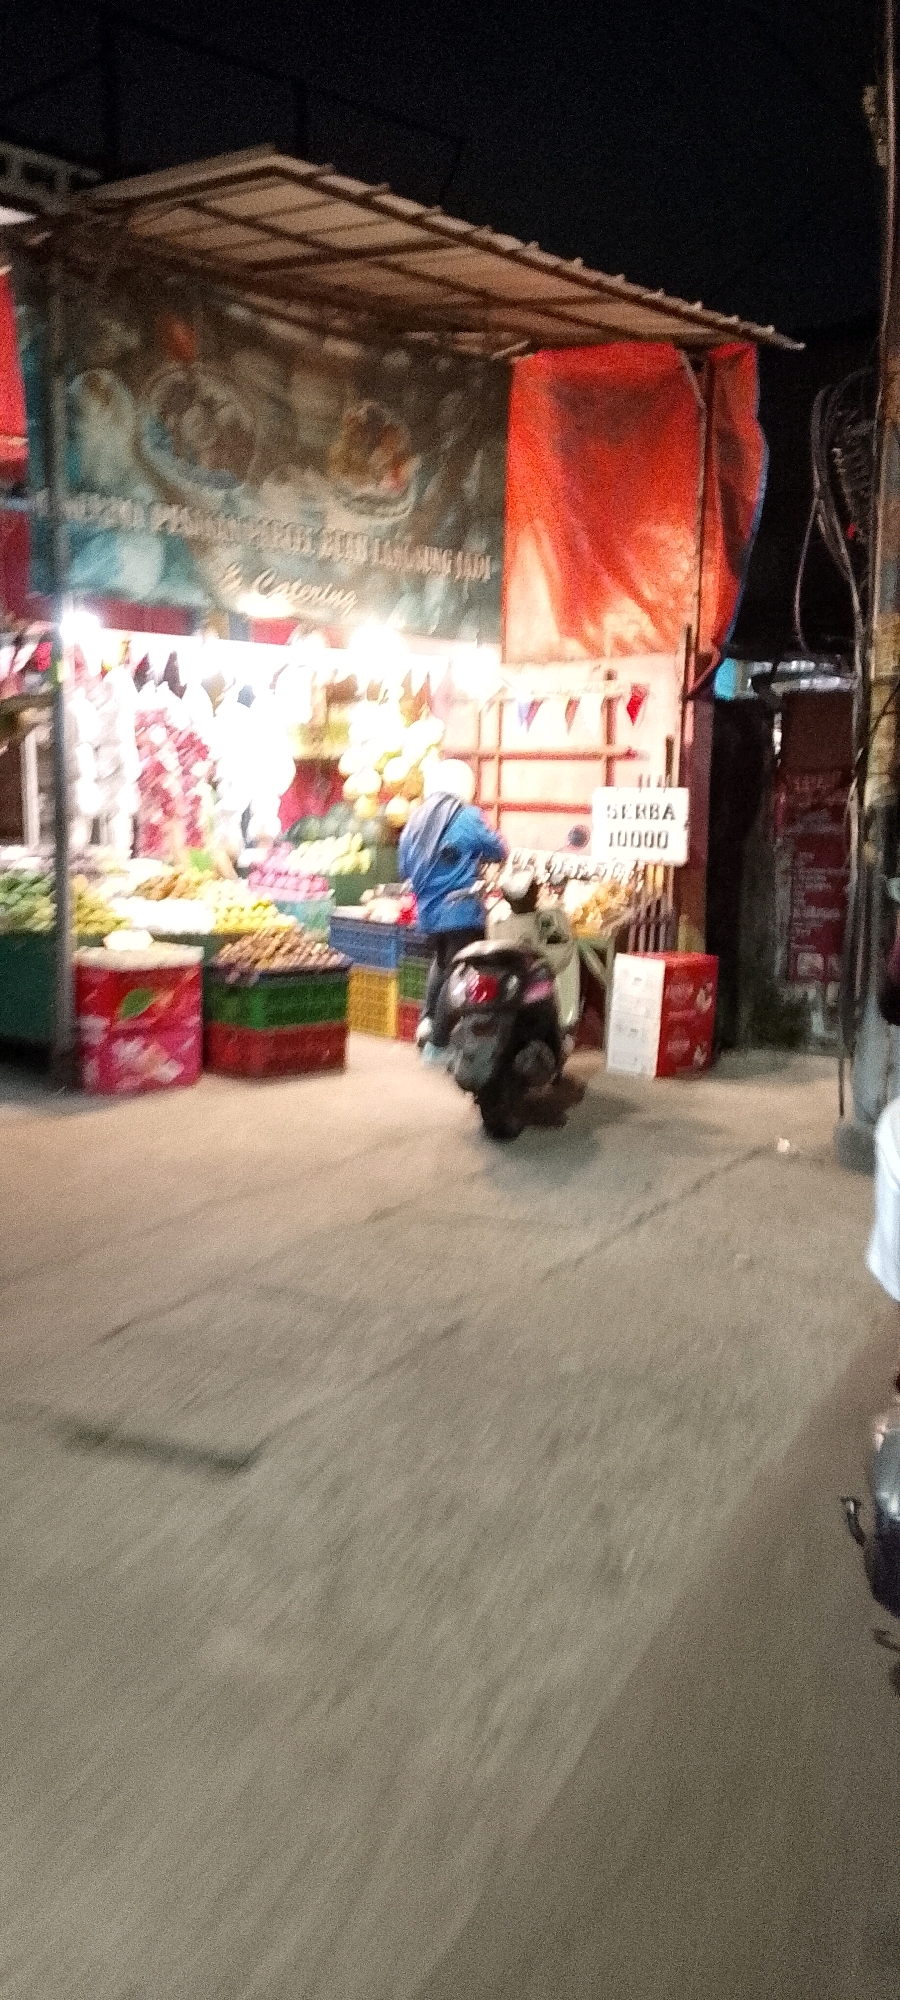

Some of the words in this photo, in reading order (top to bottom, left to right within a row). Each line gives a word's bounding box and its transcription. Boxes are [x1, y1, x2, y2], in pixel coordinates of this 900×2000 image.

[252, 567, 358, 616] Catering
[606, 802, 677, 822] SERBA
[608, 829, 670, 850] 10000
